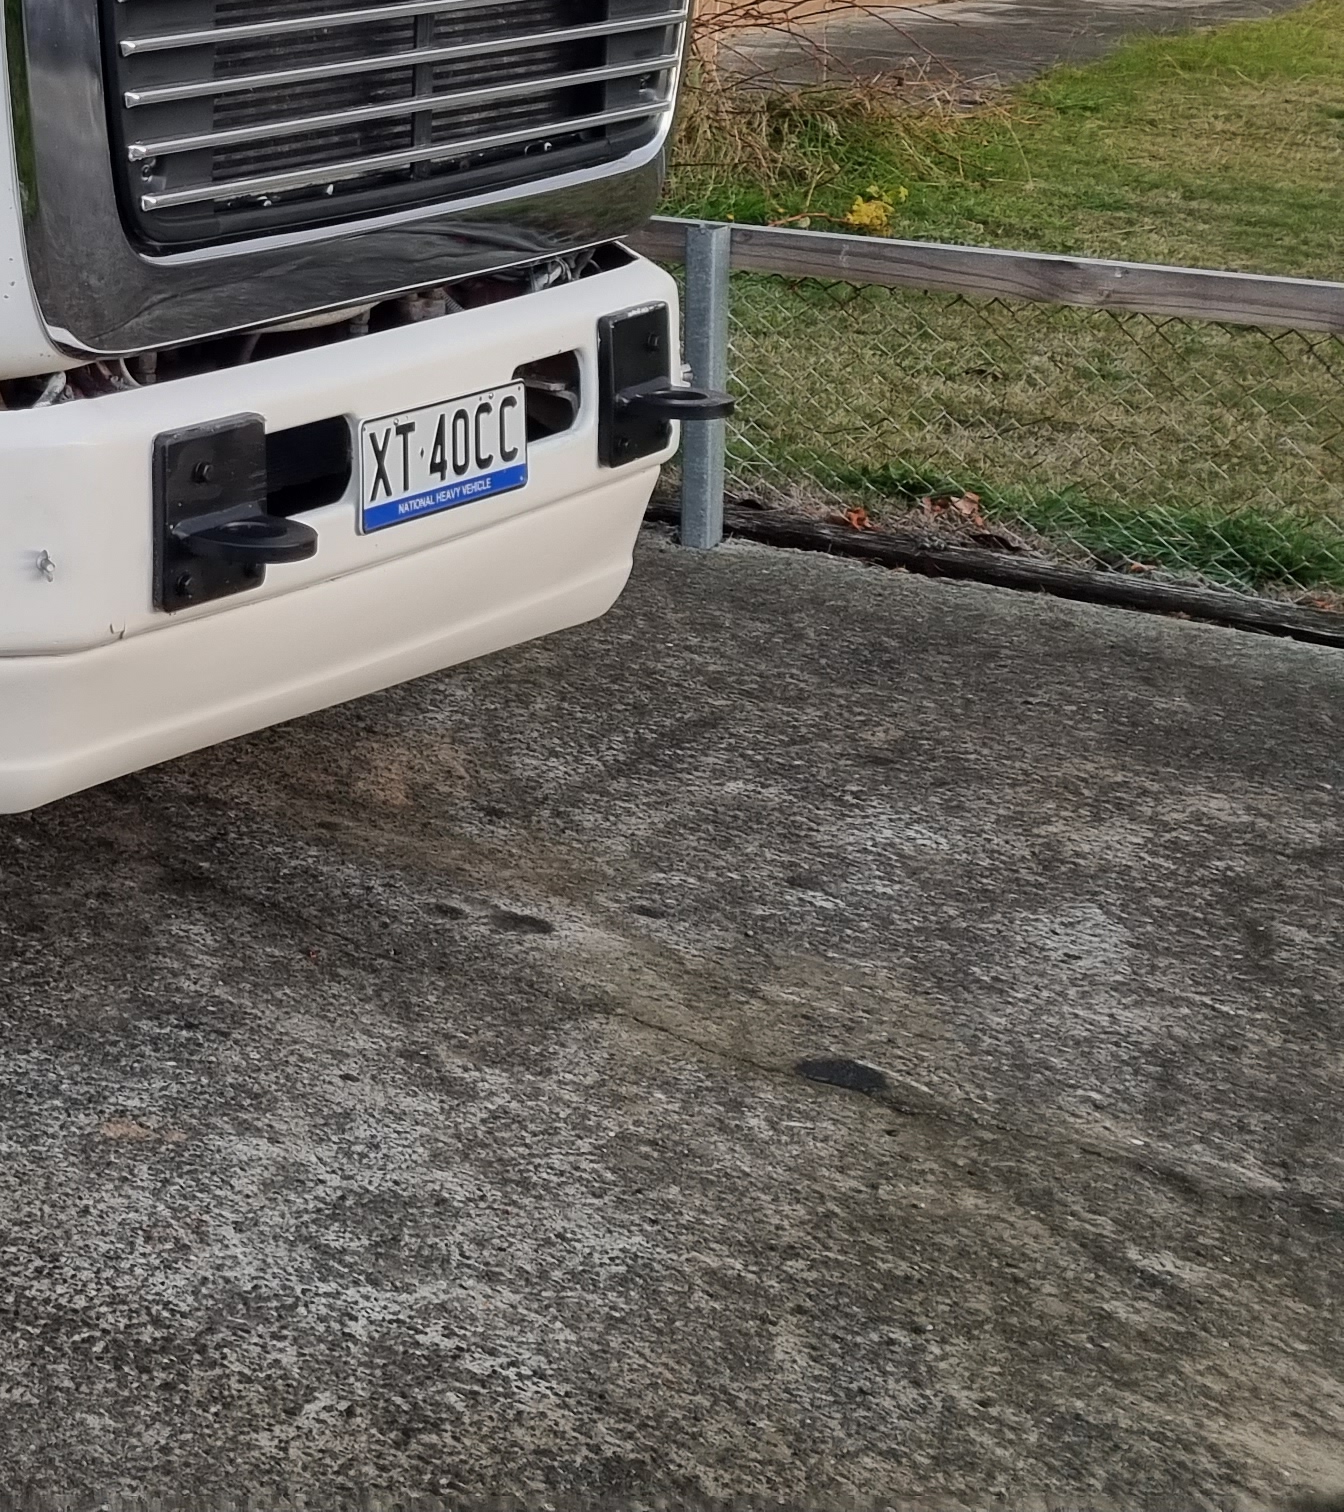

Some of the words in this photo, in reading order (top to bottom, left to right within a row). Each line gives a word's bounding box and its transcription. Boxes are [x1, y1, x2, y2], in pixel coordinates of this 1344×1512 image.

[368, 421, 415, 502] XT
[429, 395, 518, 481] 40CC
[398, 495, 435, 515] NATIONAL
[436, 487, 461, 504] HEAVY
[461, 477, 492, 496] VEHICLE
